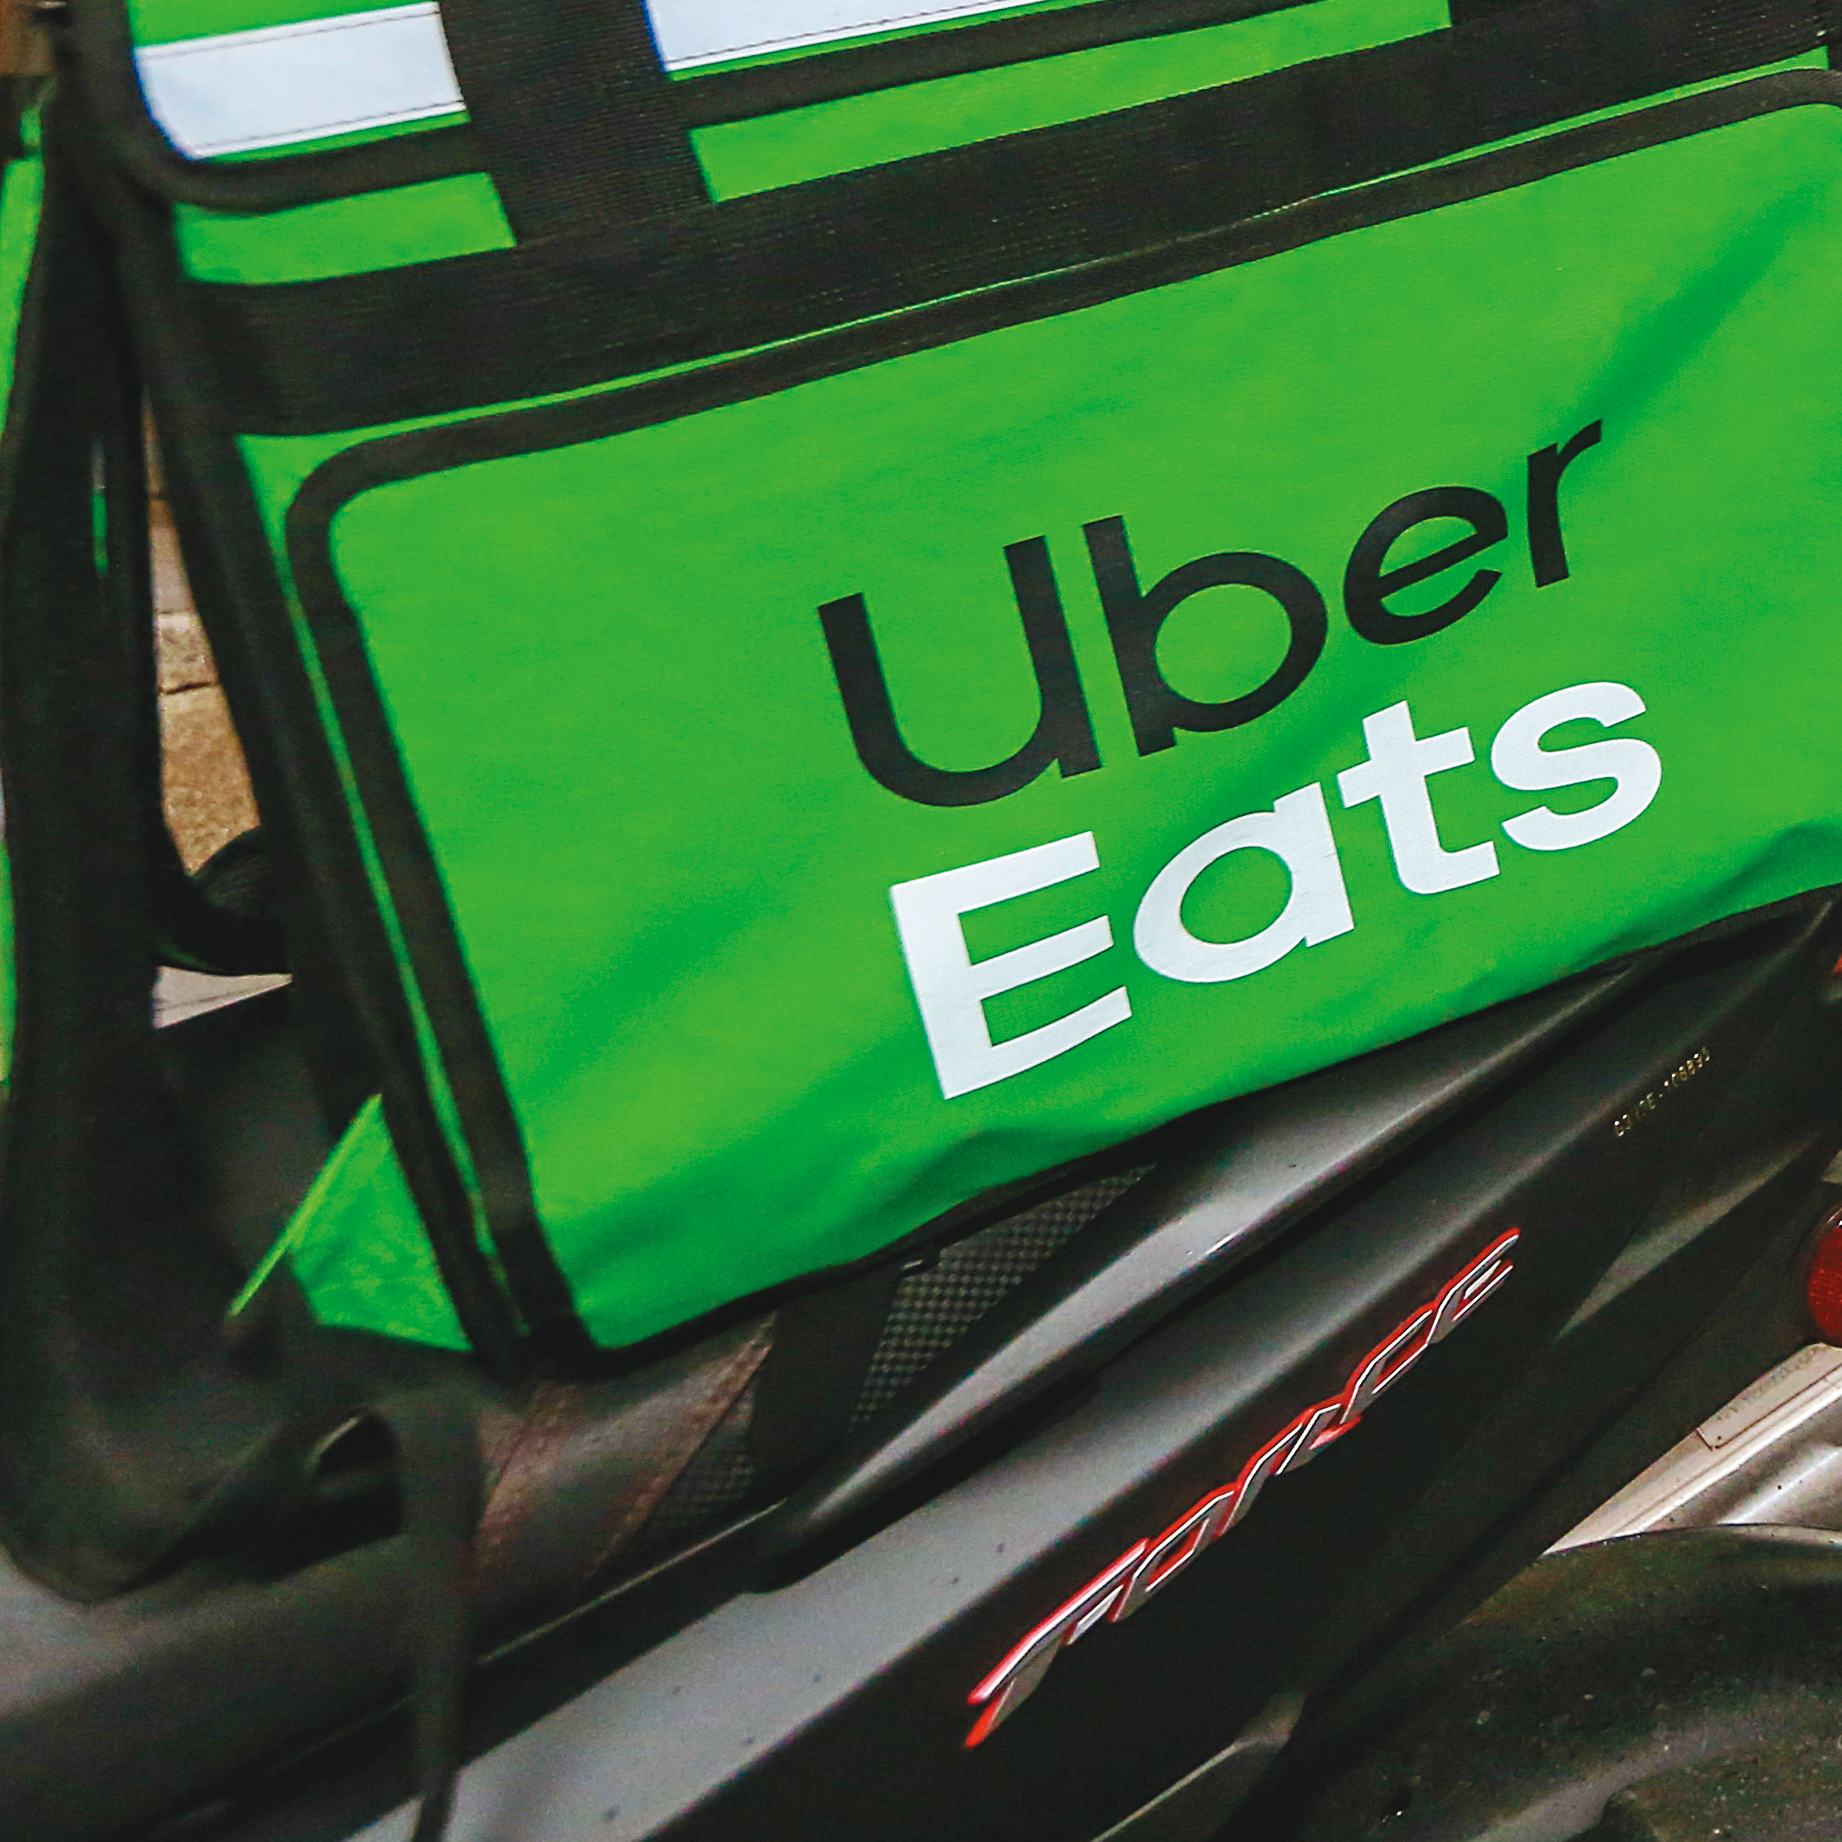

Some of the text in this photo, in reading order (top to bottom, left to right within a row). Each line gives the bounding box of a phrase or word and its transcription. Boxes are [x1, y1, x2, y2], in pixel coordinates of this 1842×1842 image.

[817, 418, 1603, 808] Uber
[888, 681, 1663, 1101] Eats
[964, 1226, 1521, 1750] FORCE
